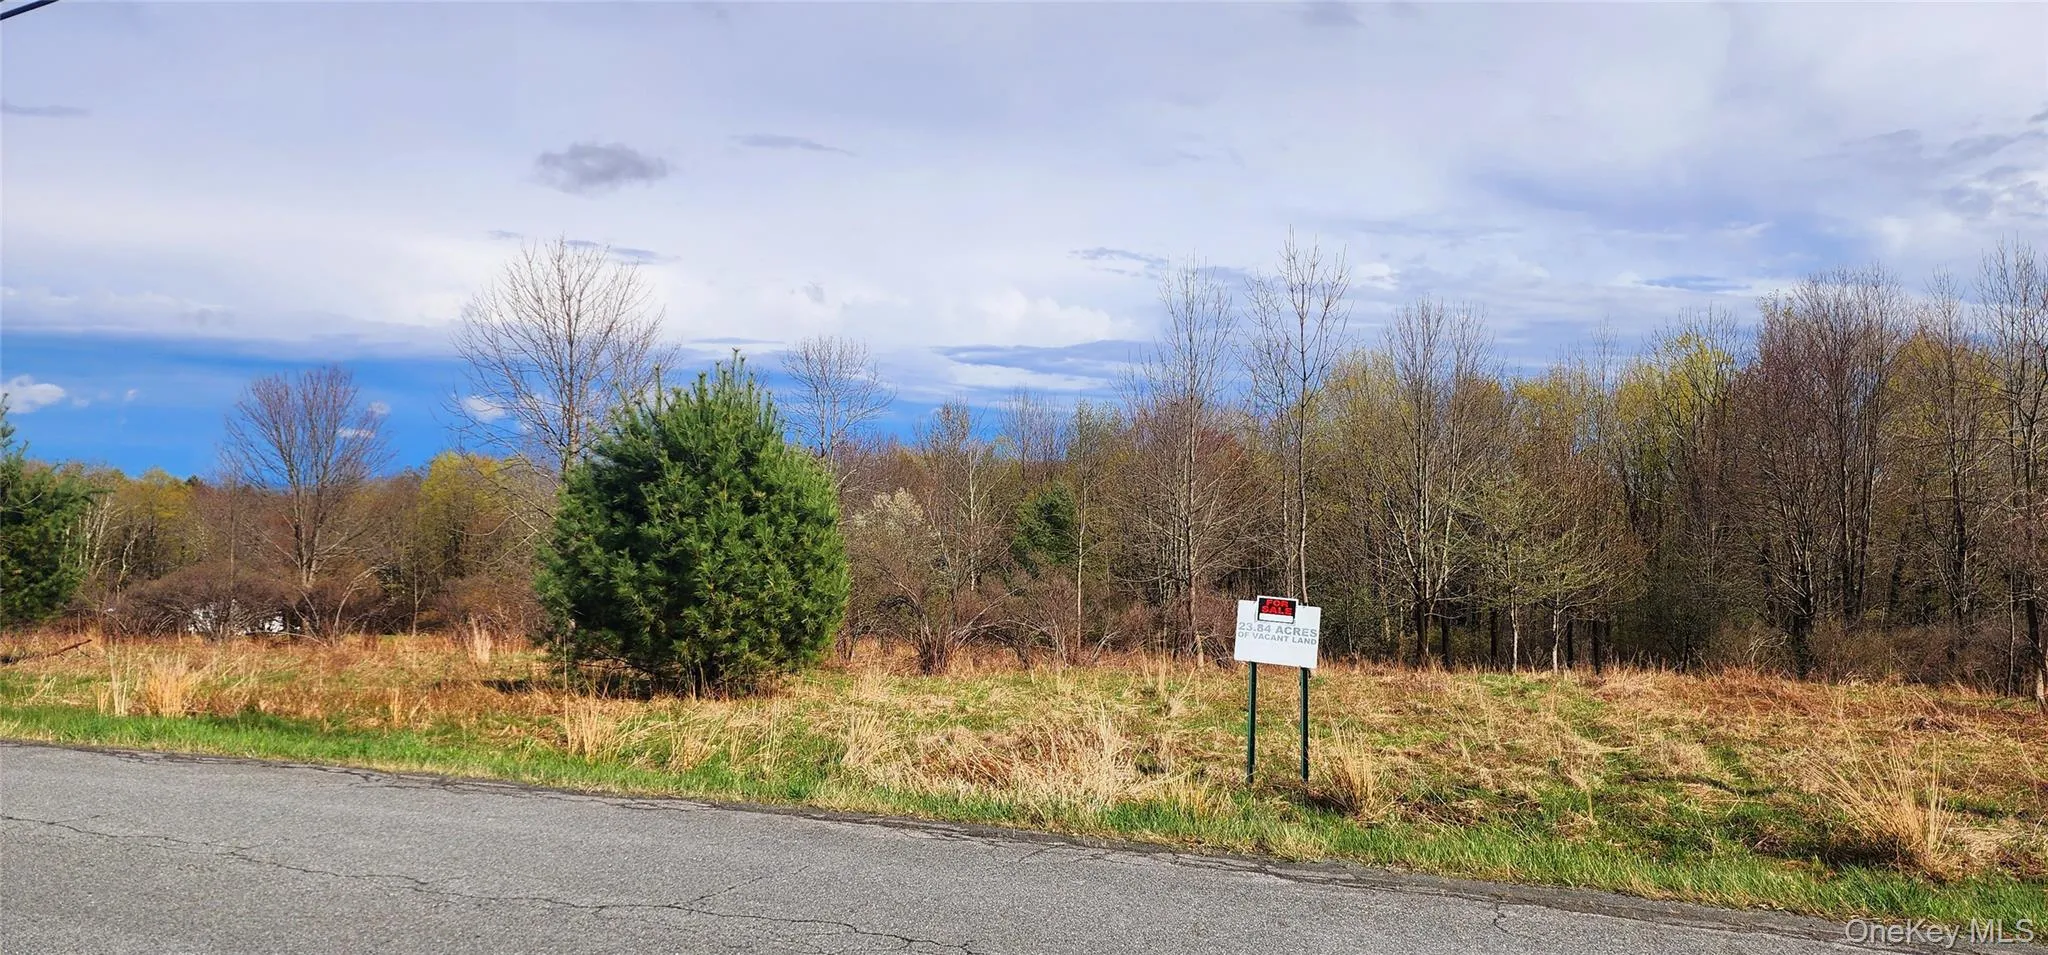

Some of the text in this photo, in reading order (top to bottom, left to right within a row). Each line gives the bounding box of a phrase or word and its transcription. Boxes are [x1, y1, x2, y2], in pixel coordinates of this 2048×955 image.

[1266, 598, 1288, 607] FOR
[1261, 606, 1292, 615] SALE
[1238, 622, 1317, 638] 23.84 ACRES
[1252, 632, 1290, 643] VACANT
[1292, 637, 1317, 645] LAND
